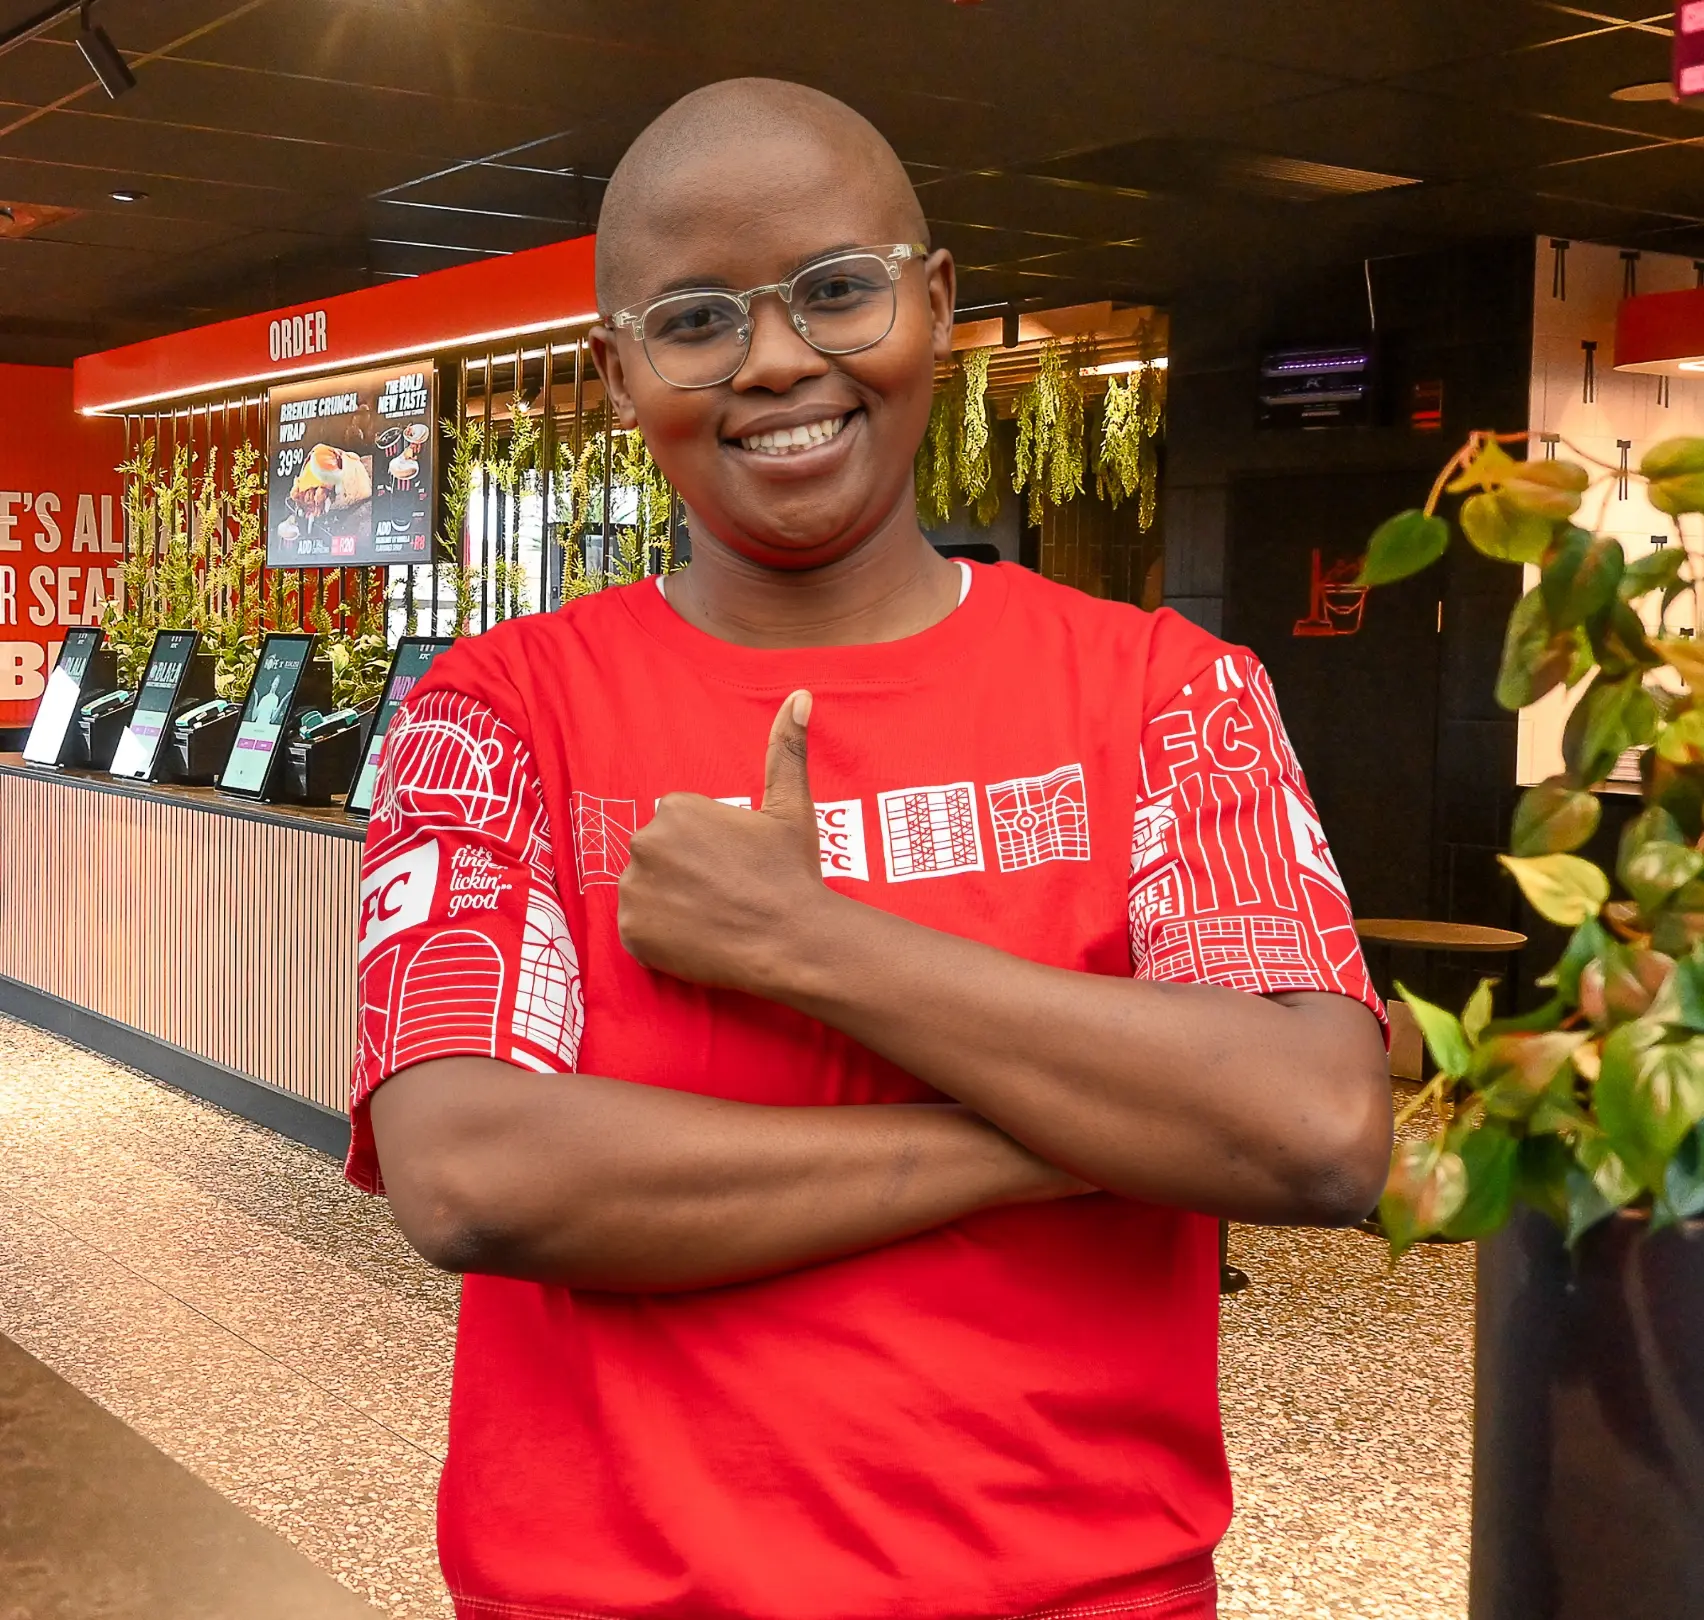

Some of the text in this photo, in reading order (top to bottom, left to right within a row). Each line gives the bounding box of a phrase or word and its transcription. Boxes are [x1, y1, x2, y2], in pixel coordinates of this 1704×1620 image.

[269, 310, 328, 362] ORDER
[385, 372, 424, 395] THE BOLD
[280, 399, 318, 423] BREKKIE
[318, 392, 358, 417] CRUNCH
[377, 394, 399, 414] NEW
[399, 389, 428, 411] TASTE
[279, 421, 306, 443] WRAP
[375, 520, 391, 536] ADD
[298, 539, 312, 555] ADD
[451, 847, 509, 875] finger
